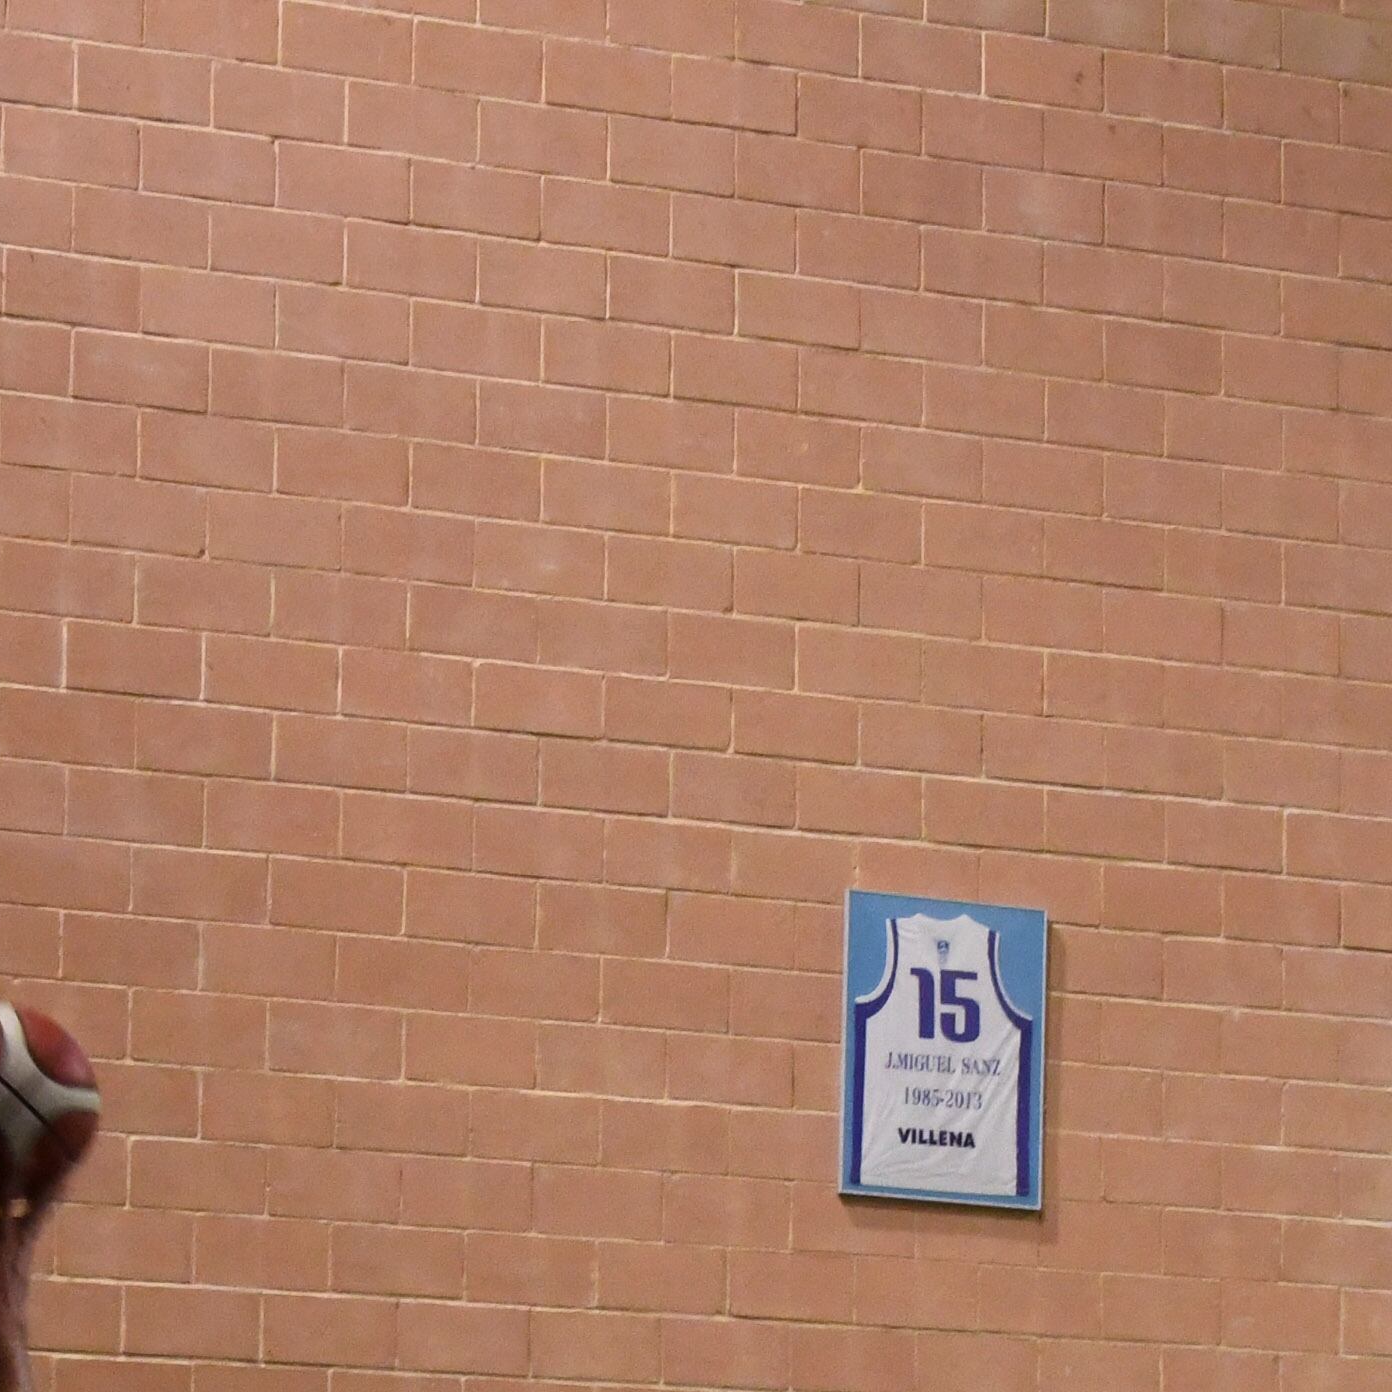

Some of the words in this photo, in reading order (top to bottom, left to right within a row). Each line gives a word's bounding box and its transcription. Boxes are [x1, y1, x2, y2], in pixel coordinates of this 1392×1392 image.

[910, 967, 981, 1043] 15
[884, 1051, 957, 1074] J.MIGUEL
[961, 1056, 1001, 1077] SANZ
[898, 1127, 975, 1149] VILLENA
